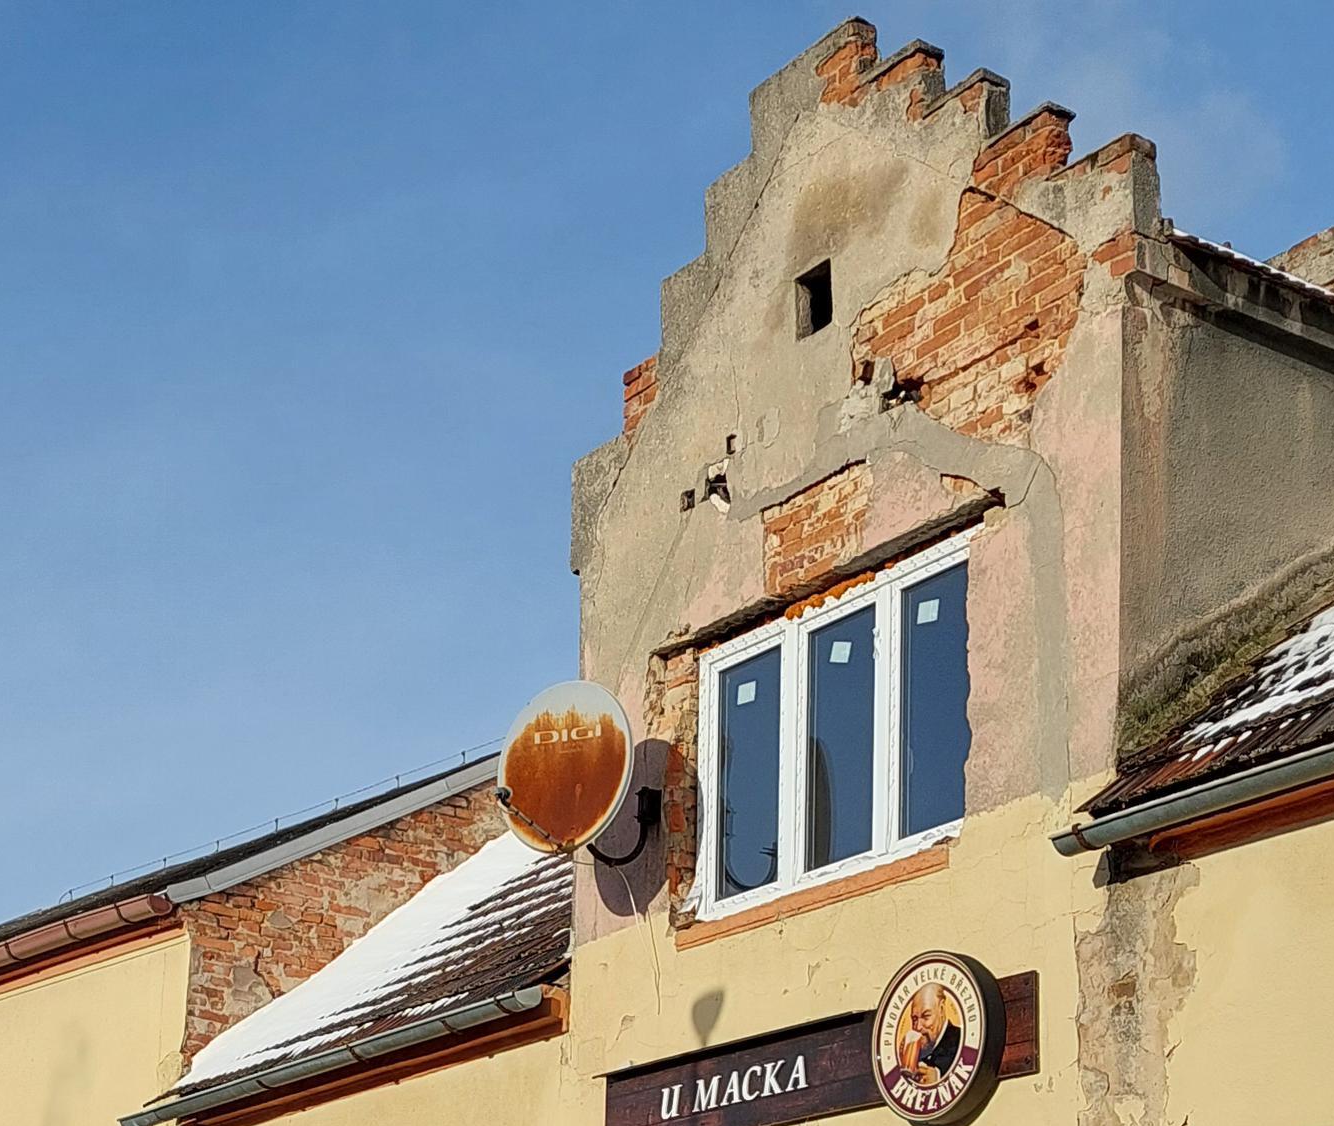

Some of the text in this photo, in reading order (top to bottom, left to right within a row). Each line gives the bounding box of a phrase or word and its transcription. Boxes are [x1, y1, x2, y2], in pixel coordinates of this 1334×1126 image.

[534, 724, 602, 745] DIGI
[884, 966, 977, 1046] PIVOVAR VELKÉ BŘEZNO
[661, 1055, 809, 1120] U MACKA
[890, 1057, 974, 1112] BŘEZŇÁK
